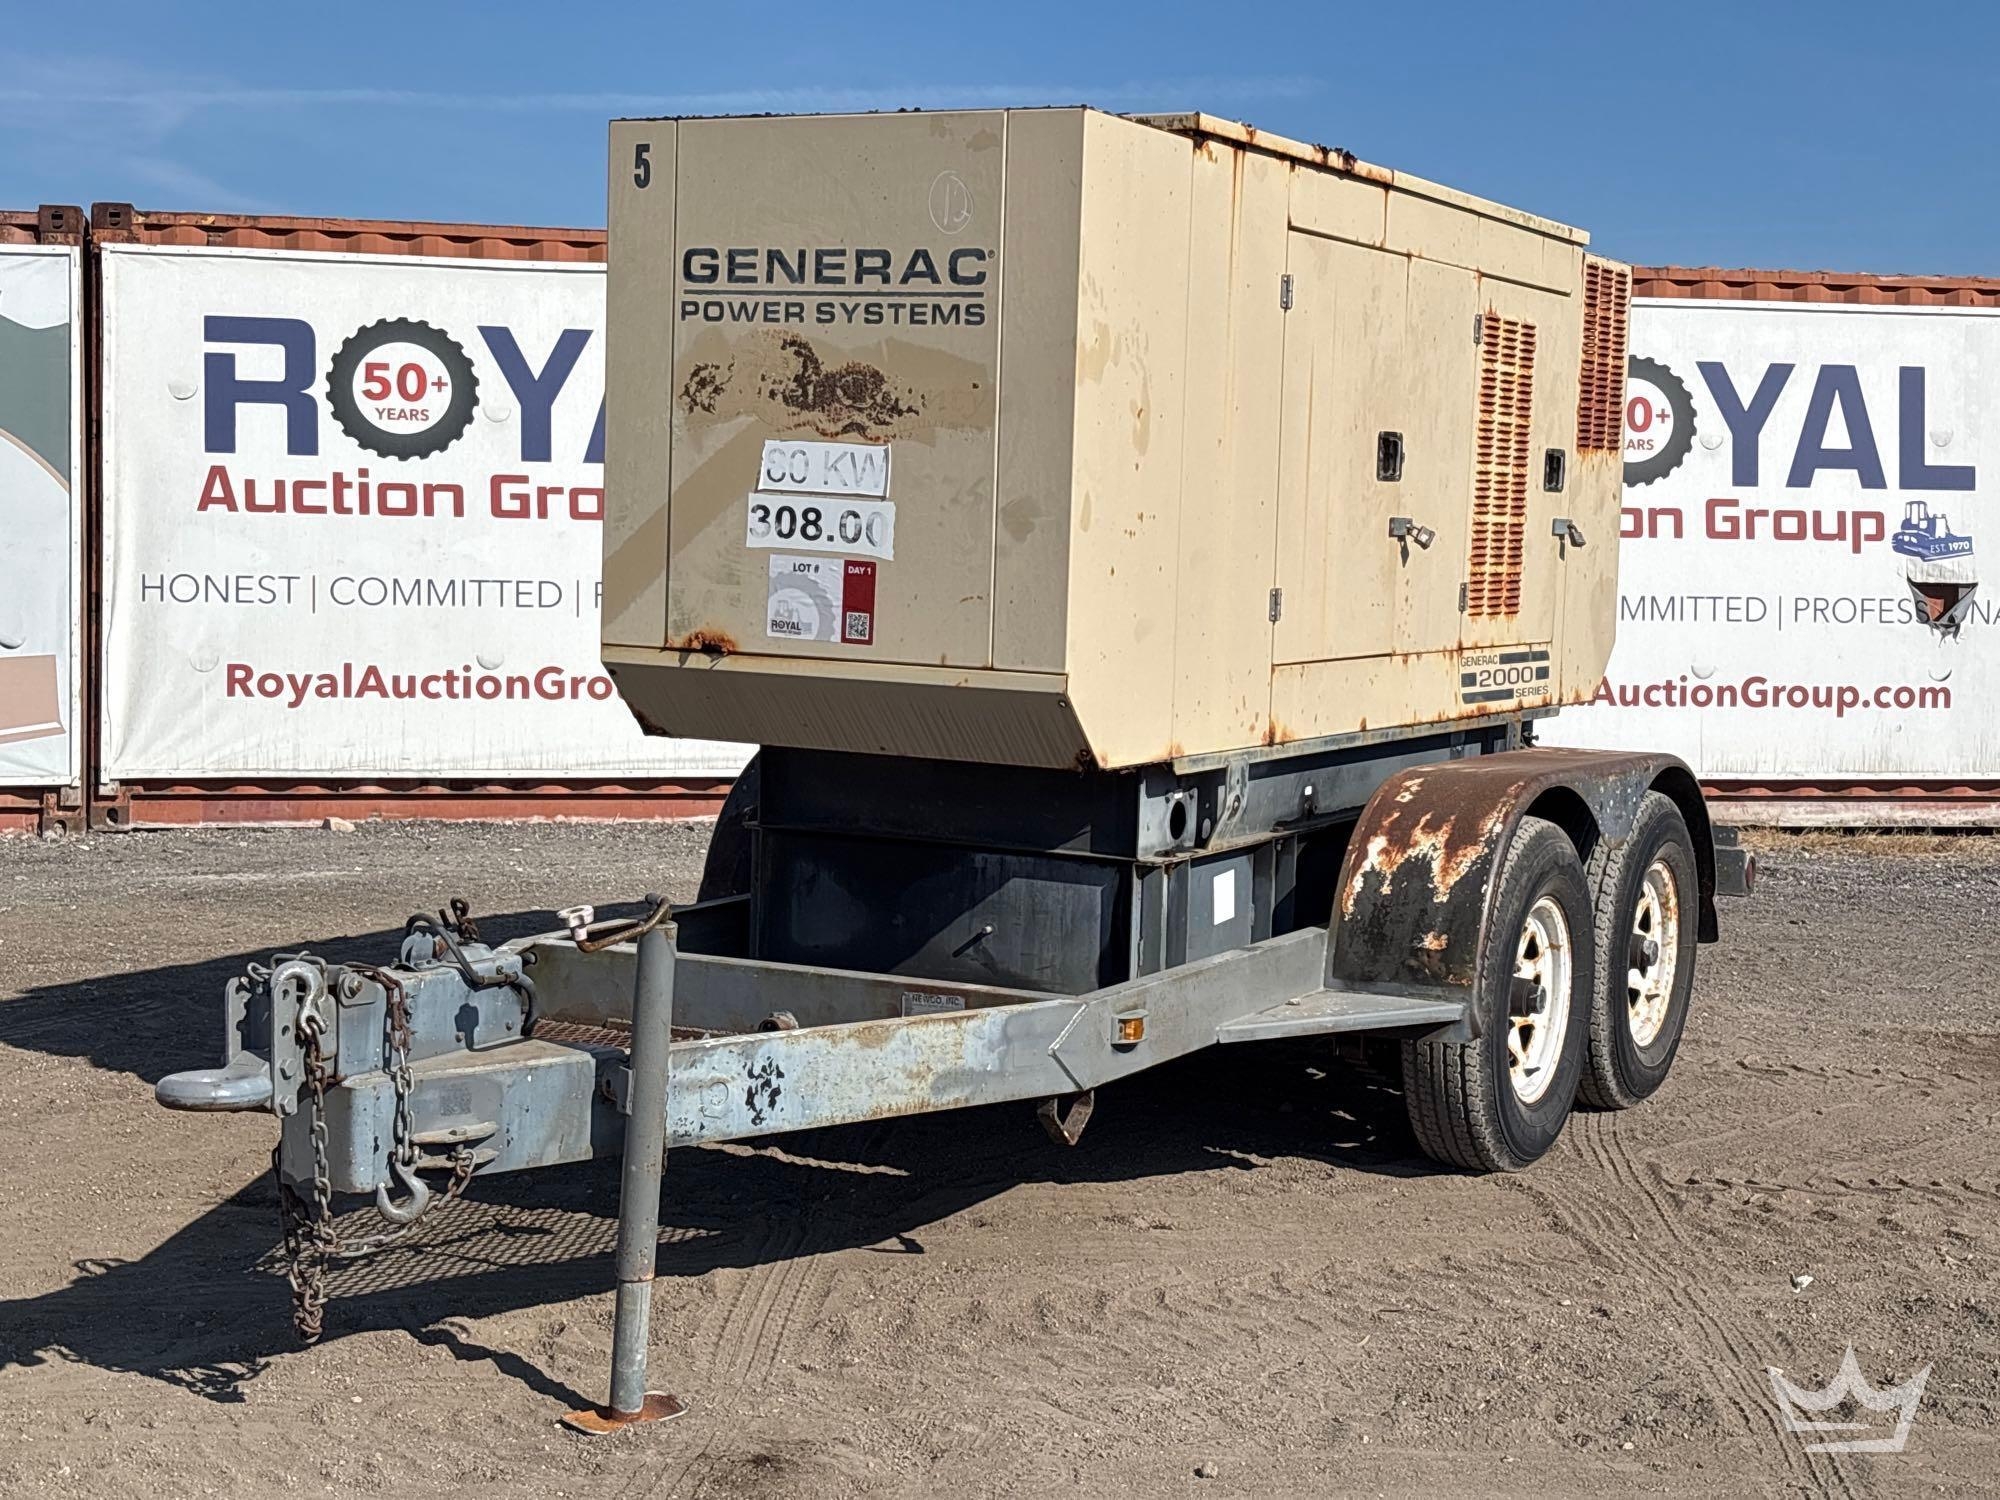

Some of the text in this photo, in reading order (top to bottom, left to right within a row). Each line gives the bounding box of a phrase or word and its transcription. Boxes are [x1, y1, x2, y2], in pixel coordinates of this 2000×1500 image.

[633, 143, 651, 189] 5
[683, 247, 987, 286] GENERAC
[680, 300, 986, 326] POWER SYSTEMS
[203, 315, 604, 463] ROY
[361, 361, 449, 403] 50+
[374, 407, 430, 422] YEARS
[1624, 438, 1655, 451] ARS
[823, 450, 888, 488] KW
[197, 465, 604, 520] Auction Gro
[749, 504, 890, 548] 308.00
[1620, 498, 1885, 554] on Group
[1948, 540, 1970, 551] 1970
[793, 562, 820, 574] LOT #
[848, 565, 872, 576] DAY 1
[140, 573, 301, 605] HONEST
[329, 576, 563, 608] COMMITTED
[771, 619, 802, 631] ROYAL
[1620, 595, 2000, 626] MMITTED PROFESSN
[1460, 654, 1498, 667] GENERAC
[225, 664, 624, 708] RoyalAuctionGro
[1479, 666, 1534, 688] 2000
[1515, 685, 1549, 698] SERIES
